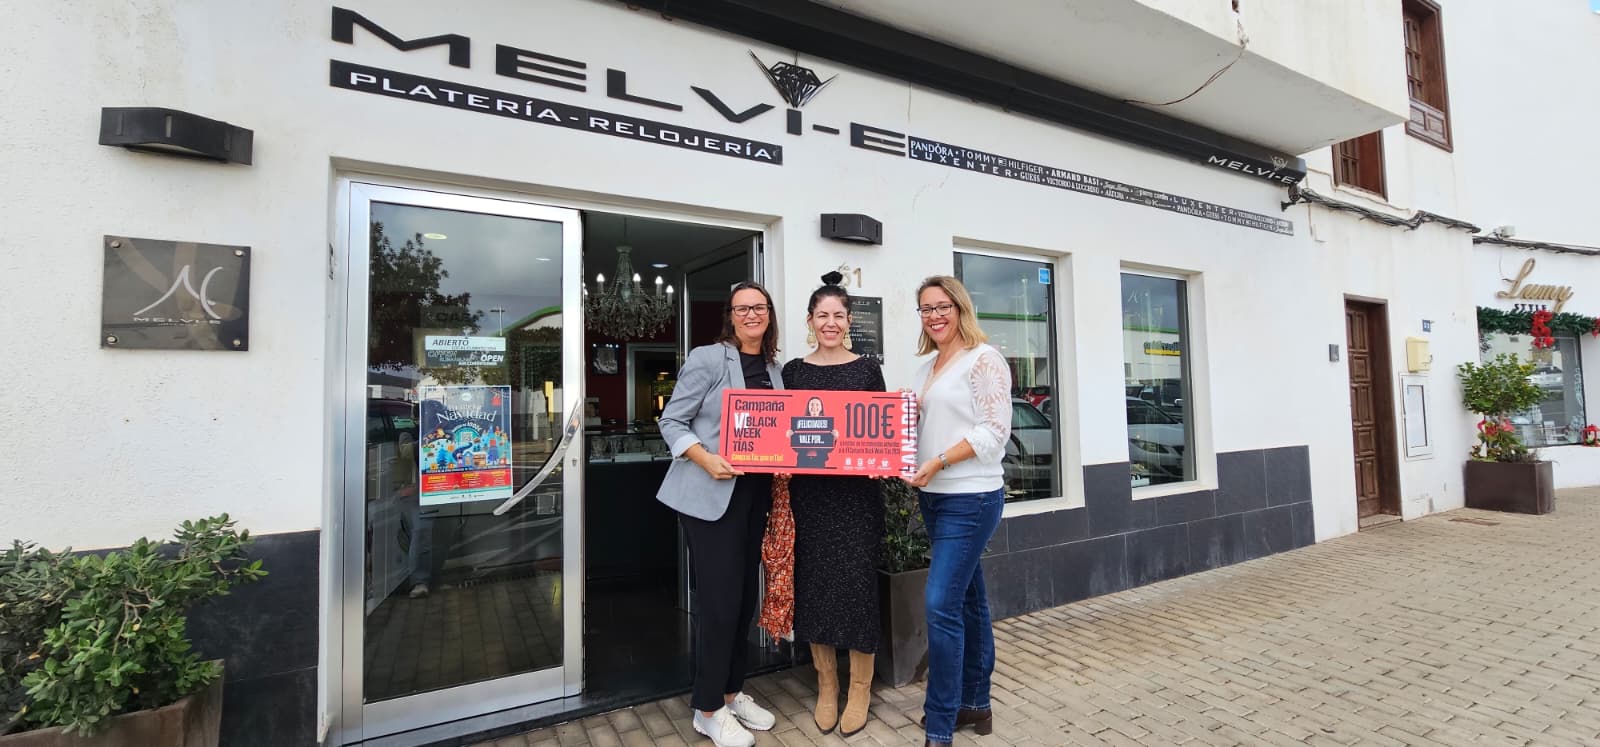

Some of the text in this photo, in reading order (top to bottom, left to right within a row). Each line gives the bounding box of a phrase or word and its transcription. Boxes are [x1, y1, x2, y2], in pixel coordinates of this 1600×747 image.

[350, 71, 561, 123] PLATERÍA
[589, 116, 772, 160] RELOJERÍA
[911, 150, 1012, 177] LUXENTER
[1208, 155, 1295, 185] MELVI-E
[960, 149, 997, 164] TOMMY
[1008, 160, 1043, 175] HILFIGER
[1051, 169, 1081, 182] ARMAND
[1083, 175, 1099, 186] BASI
[1173, 196, 1234, 215] LUXENTER
[432, 339, 469, 347] ABIERTO
[480, 354, 504, 362] OPEN
[735, 399, 785, 412] Campaña
[436, 409, 497, 423] Navidad
[746, 416, 777, 428] BLACK
[845, 402, 895, 440] 100€
[734, 428, 761, 438] WEEK
[733, 439, 754, 452] TÍAS
